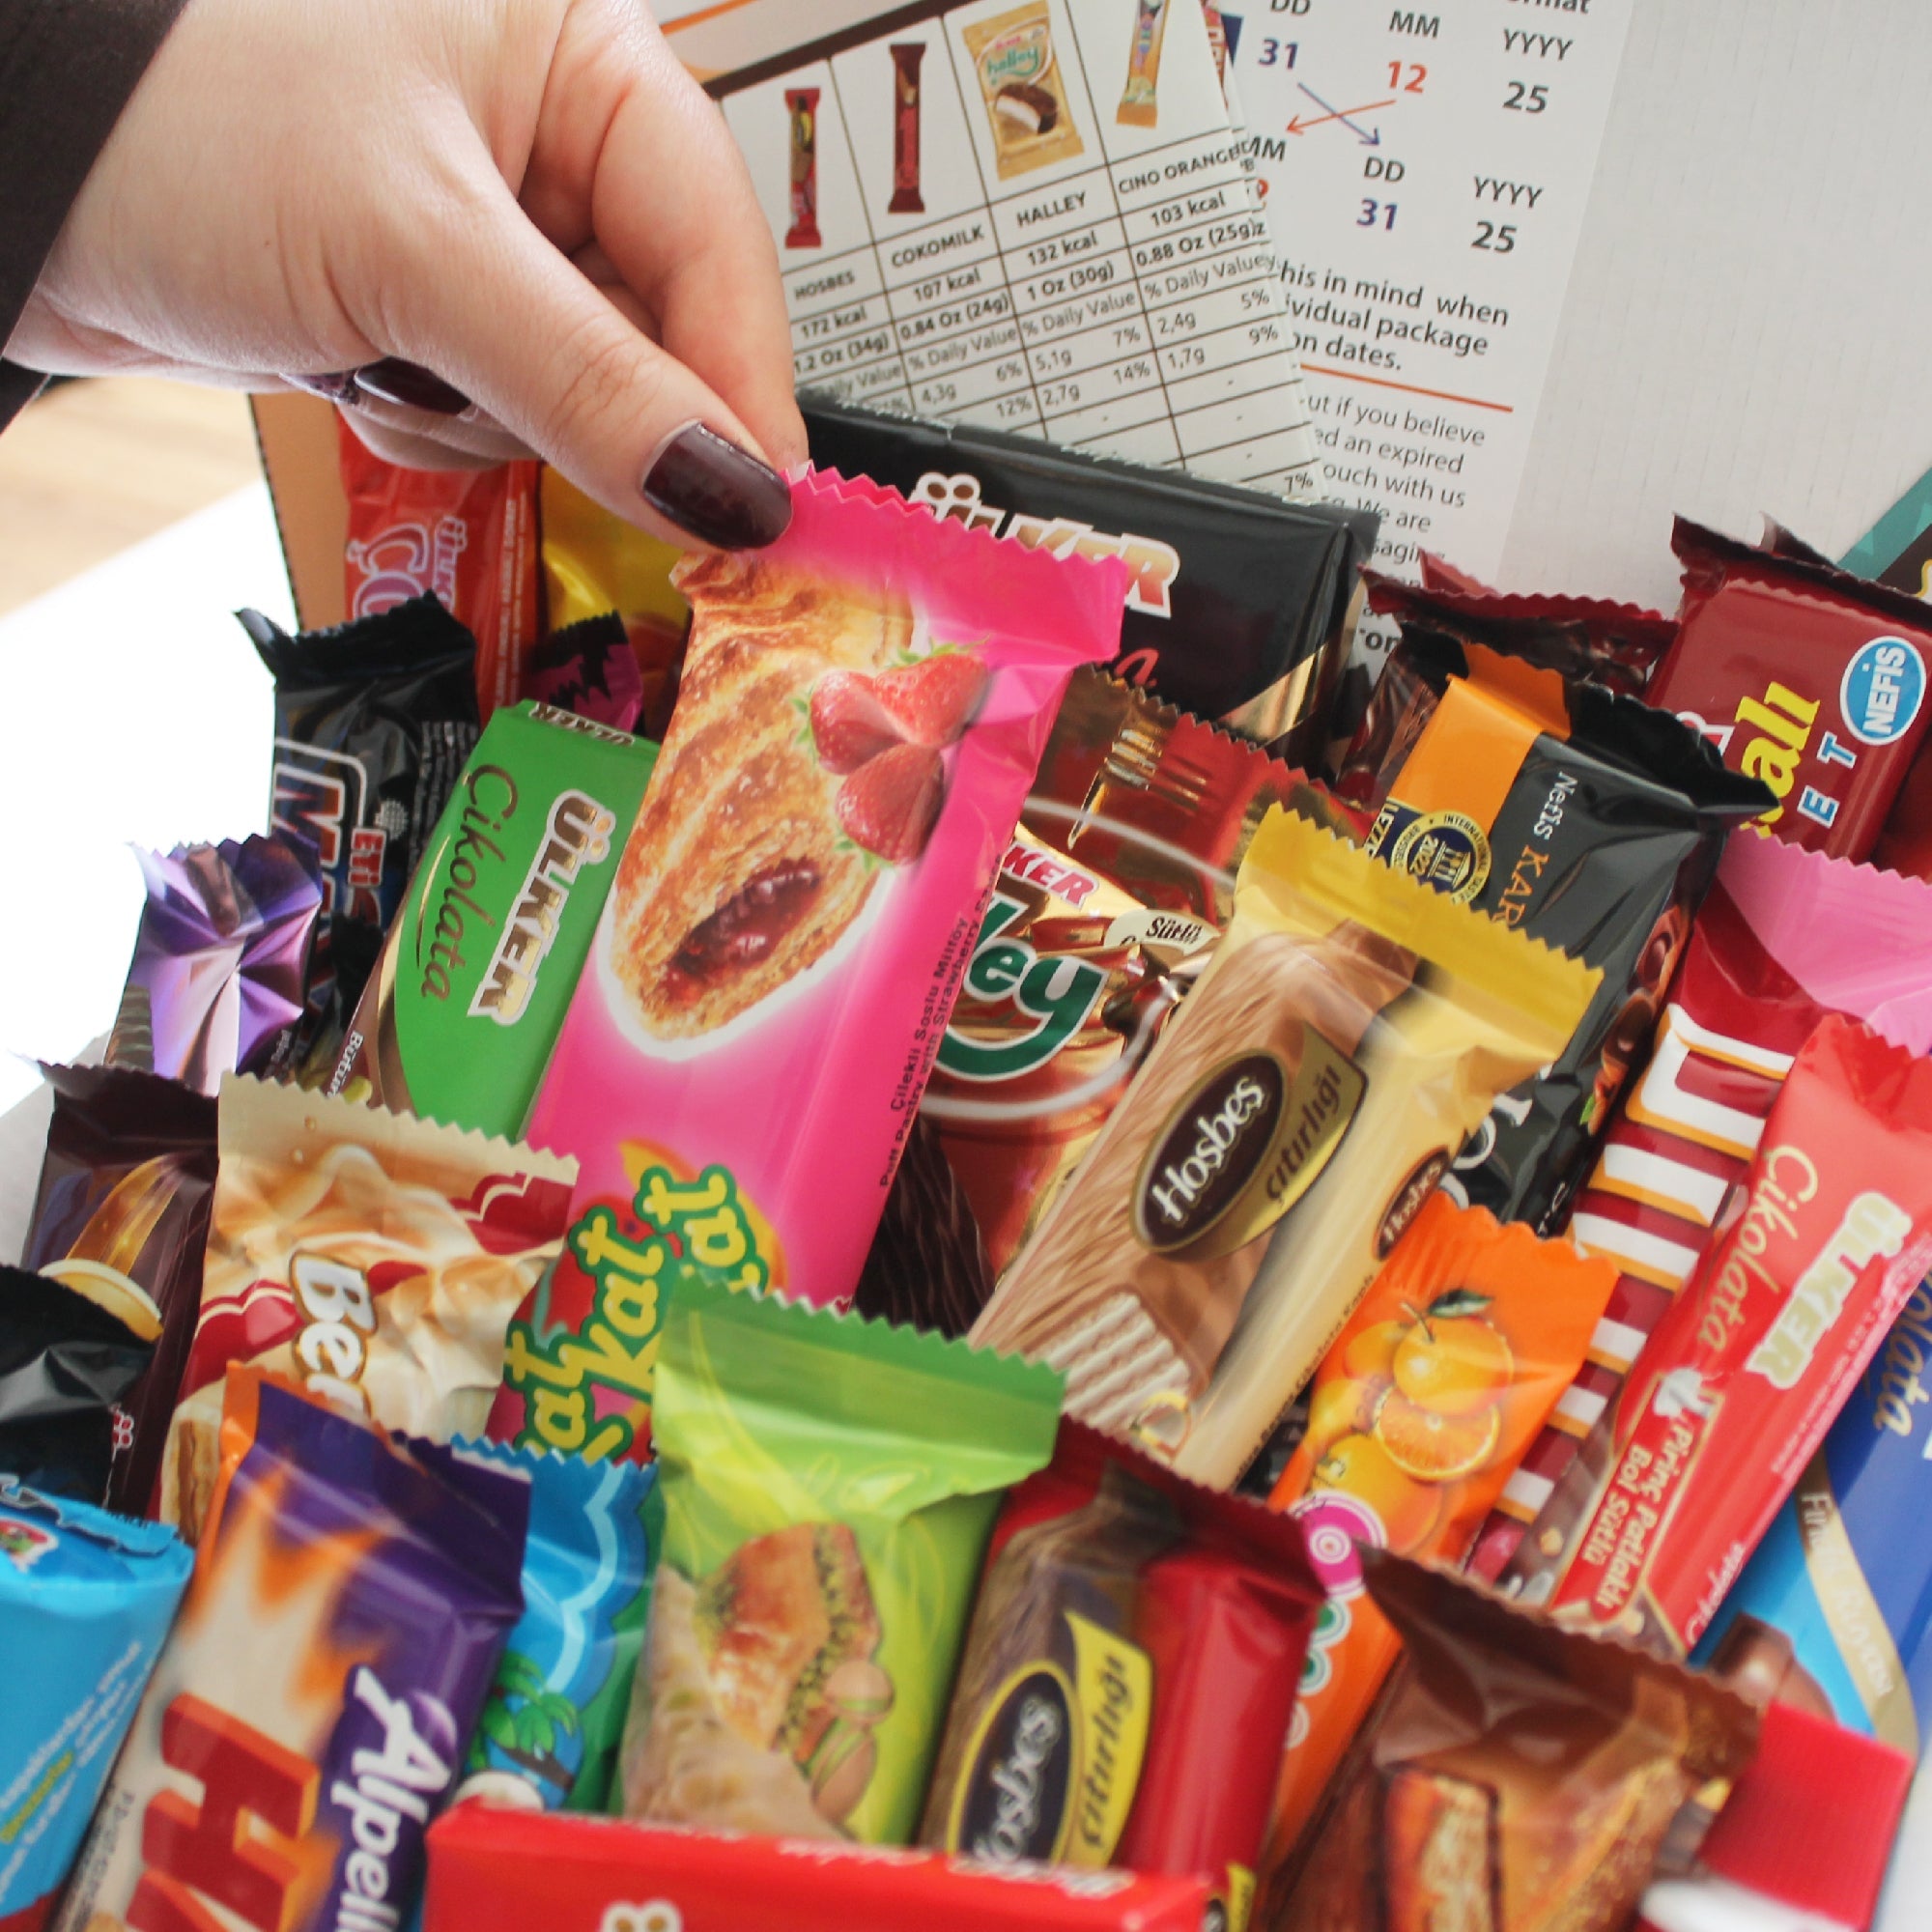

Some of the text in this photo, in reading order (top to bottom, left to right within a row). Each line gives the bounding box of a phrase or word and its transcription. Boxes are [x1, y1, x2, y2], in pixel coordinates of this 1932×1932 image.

[1388, 10, 1441, 39] MM
[1258, 38, 1300, 70] 31
[1503, 28, 1574, 62] YYYY
[1387, 60, 1428, 94] 12
[1502, 80, 1549, 115] 25
[1118, 171, 1160, 195] CINO
[1363, 156, 1406, 184] DD
[1016, 190, 1087, 228] HALLEY
[1151, 192, 1227, 227] 103 kcal
[1473, 175, 1544, 210] YYYY
[1355, 197, 1399, 232] 31
[892, 225, 984, 269] COKOMILK
[1027, 230, 1098, 267] 132 kcal
[1136, 218, 1257, 268] 0.88 Oz (25g)
[1470, 220, 1518, 254] 25
[795, 270, 855, 300] HOSBES
[915, 268, 981, 301] 107 kcal
[1027, 260, 1115, 301] 1 Oz (30g)
[1145, 283, 1161, 299] %
[1165, 268, 1209, 293] Daily
[1279, 260, 1509, 327] his in mind when
[899, 294, 1009, 341] 0.84 Oz (24g)
[1023, 291, 1136, 335] % Daily Value
[1240, 289, 1269, 311] 5%
[801, 303, 867, 338] 172 kcal
[1113, 327, 1141, 348] 7%
[1158, 311, 1197, 335] 2,4g
[1248, 324, 1279, 346] 9%
[1377, 315, 1489, 357] package
[821, 350, 842, 366] Oz
[927, 342, 967, 366] Daily
[971, 327, 1017, 352] Value
[1035, 349, 1072, 373] 5,1g
[1167, 347, 1206, 370] 1,7g
[1326, 335, 1401, 370] dates.
[996, 360, 1023, 383] 6%
[1114, 362, 1151, 385] 14%
[997, 396, 1033, 418] 12%
[1042, 384, 1080, 409] 2,7g
[1308, 394, 1486, 446] ut if you believe
[1344, 437, 1372, 455] an
[1378, 443, 1464, 473] expired
[1284, 472, 1314, 495] 7%
[1323, 464, 1465, 508] ouch with us
[1396, 512, 1432, 532] are
[1003, 843, 1099, 909] KER
[467, 788, 616, 1027] ÜLKER
[918, 1032, 941, 1074] with
[935, 919, 980, 1025] Strawberry
[891, 1047, 920, 1111] Çilekli
[915, 984, 941, 1041] Soslu
[1151, 1076, 1266, 1224] Hosbes
[1746, 1191, 1914, 1390] ÜLKER
[1640, 1423, 1694, 1502] Pirinç
[1581, 1445, 1653, 1566] Bol Sütlü
